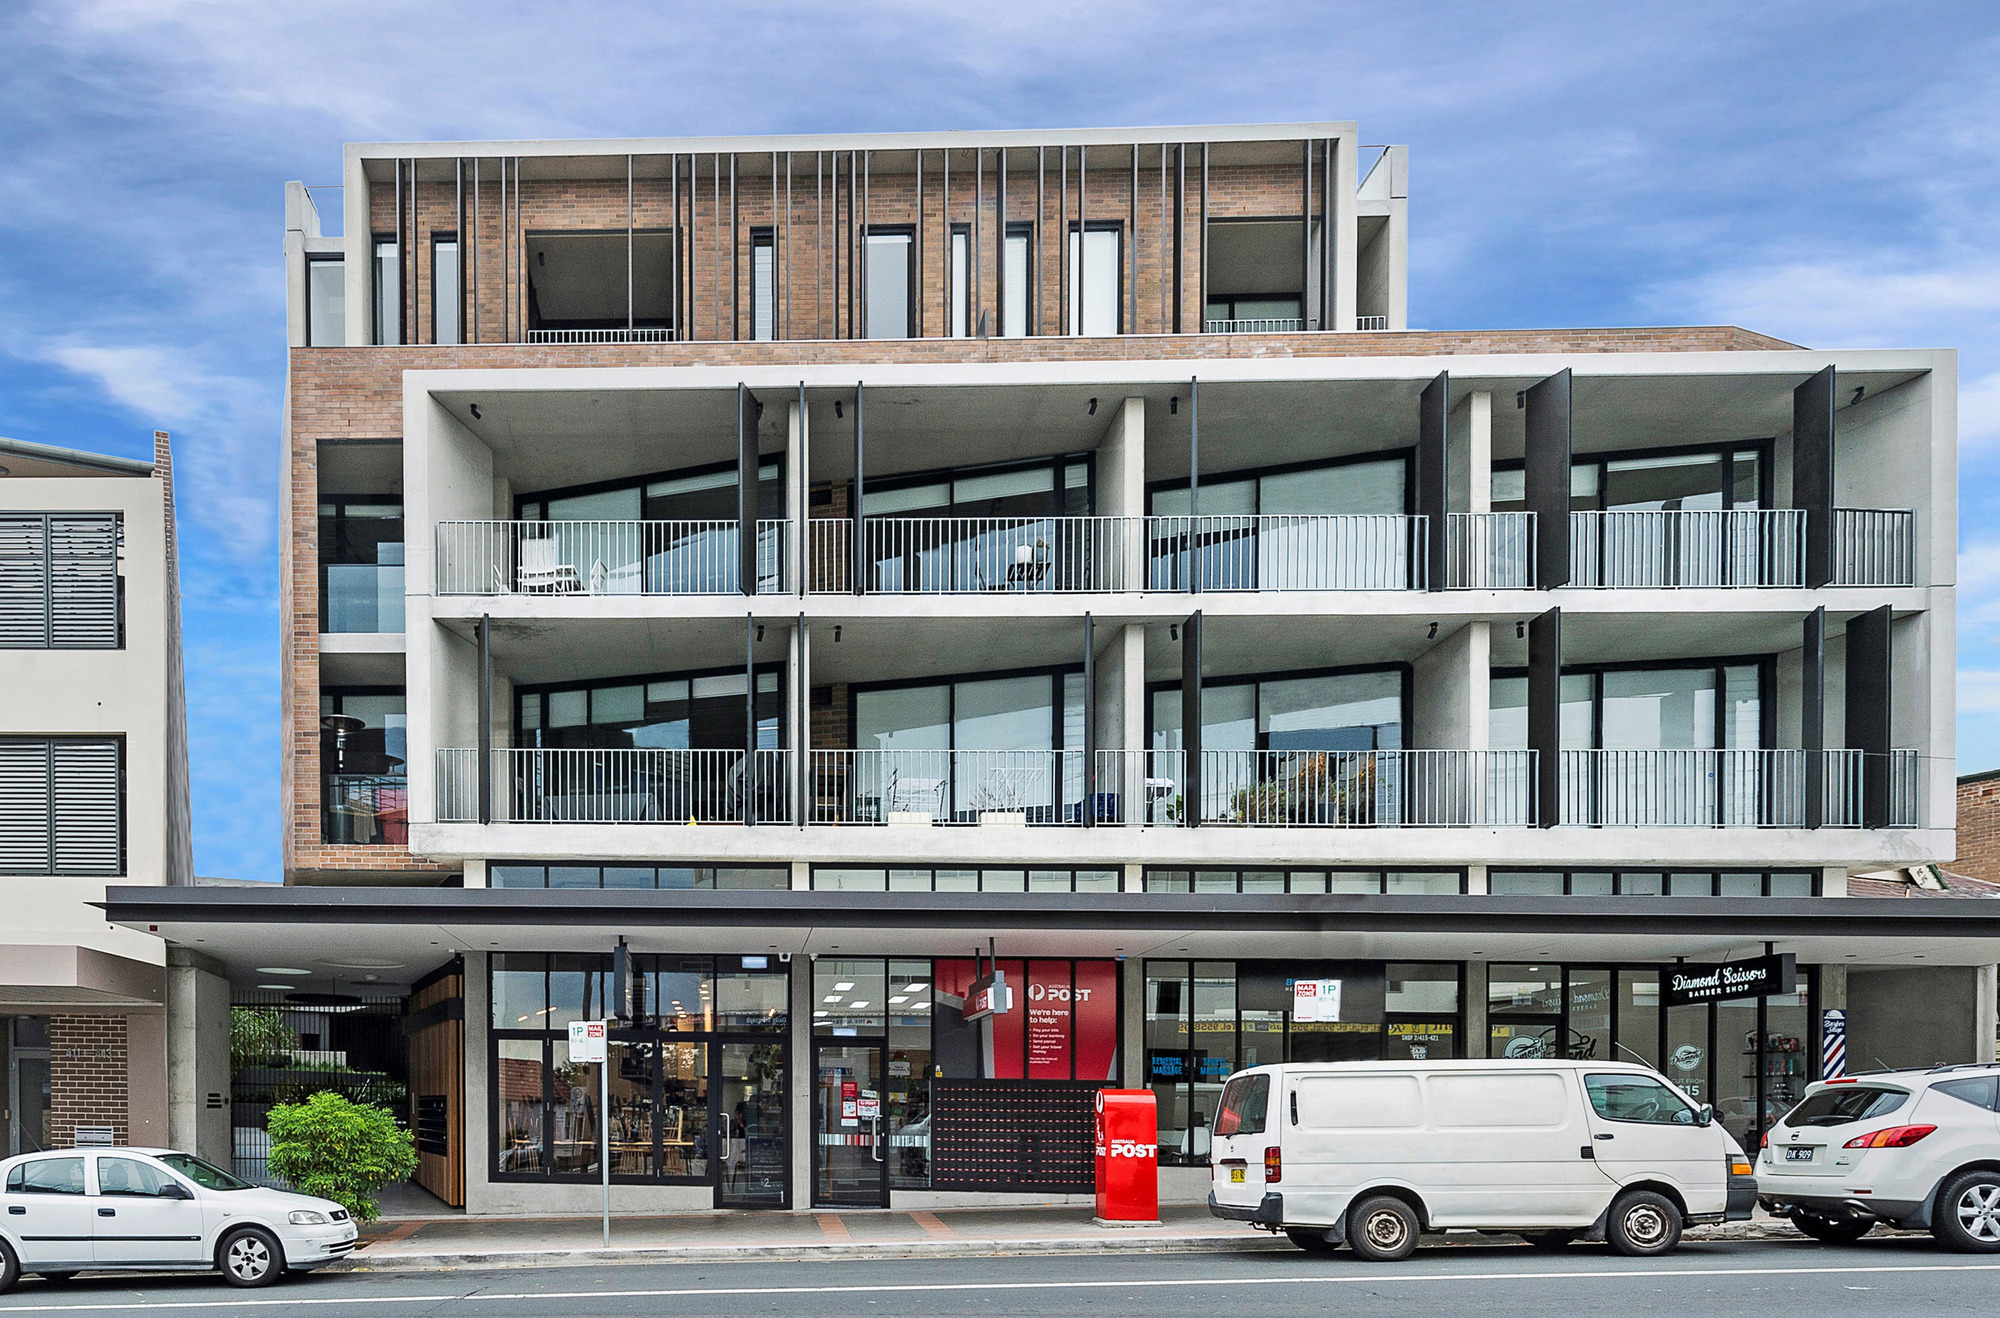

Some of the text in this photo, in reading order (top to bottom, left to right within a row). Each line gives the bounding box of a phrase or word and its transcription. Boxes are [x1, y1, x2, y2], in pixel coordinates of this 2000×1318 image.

[1672, 967, 1766, 990] Diamond Scissors
[1048, 988, 1092, 1001] POST
[1322, 985, 1337, 994] 1P
[1688, 984, 1749, 998] BARBER SHOP
[1039, 1016, 1058, 1025] help:
[572, 1026, 584, 1036] 1P
[1503, 1039, 1545, 1059] amond
[1152, 1066, 1183, 1075] MASSAGE
[1111, 1144, 1158, 1158] POST
